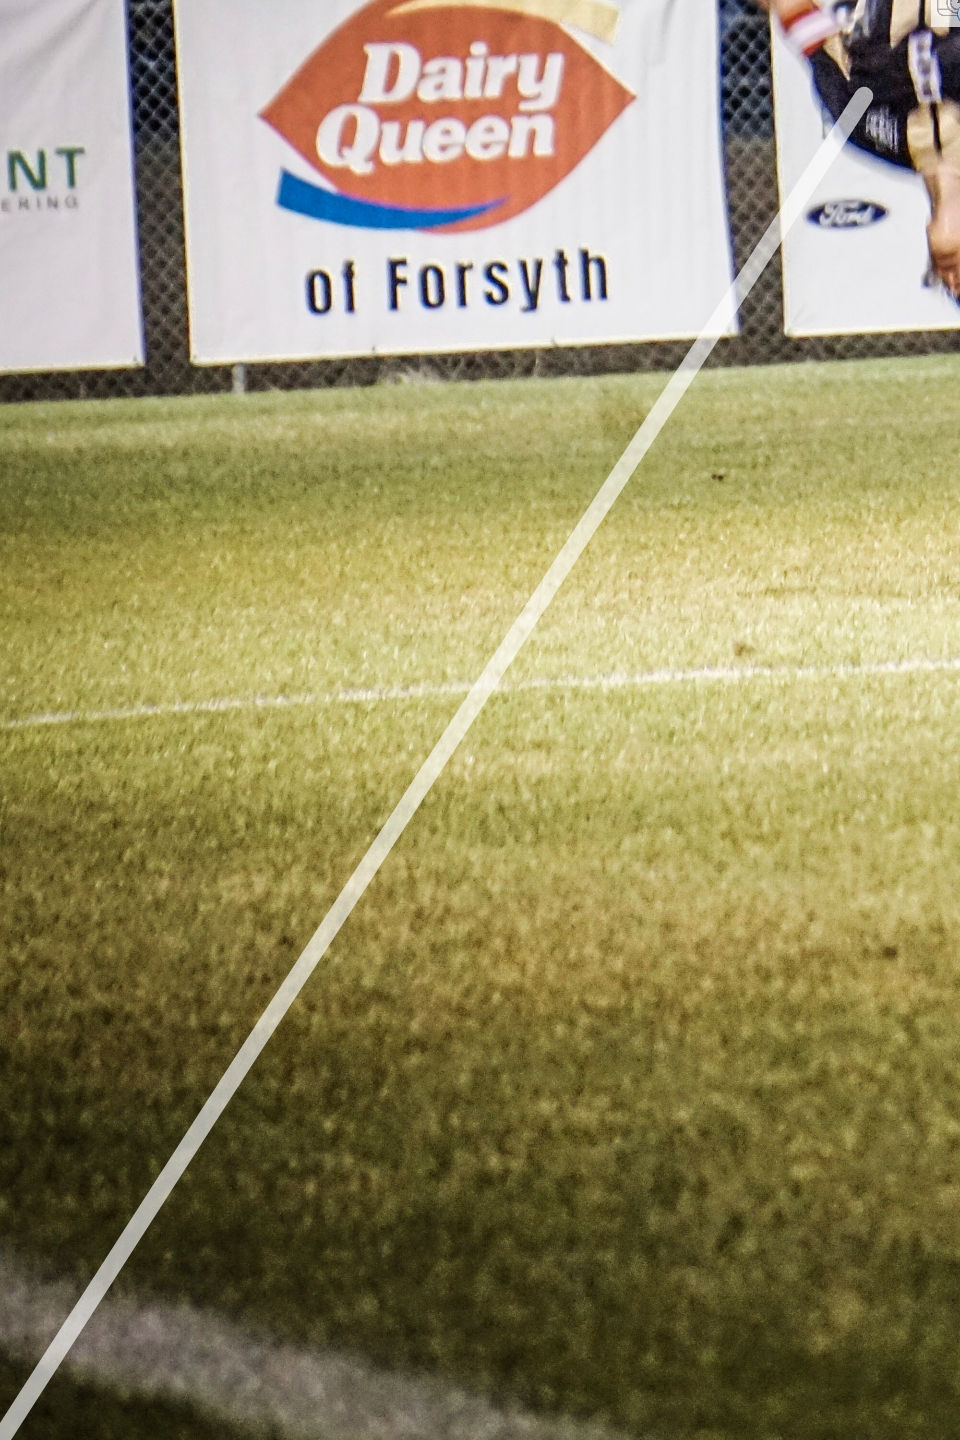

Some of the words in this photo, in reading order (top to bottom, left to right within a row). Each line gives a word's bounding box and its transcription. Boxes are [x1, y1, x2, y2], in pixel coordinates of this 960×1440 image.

[358, 41, 564, 111] Dairy
[316, 104, 554, 175] Queen
[305, 259, 355, 313] of
[386, 247, 607, 312] Forsyth
